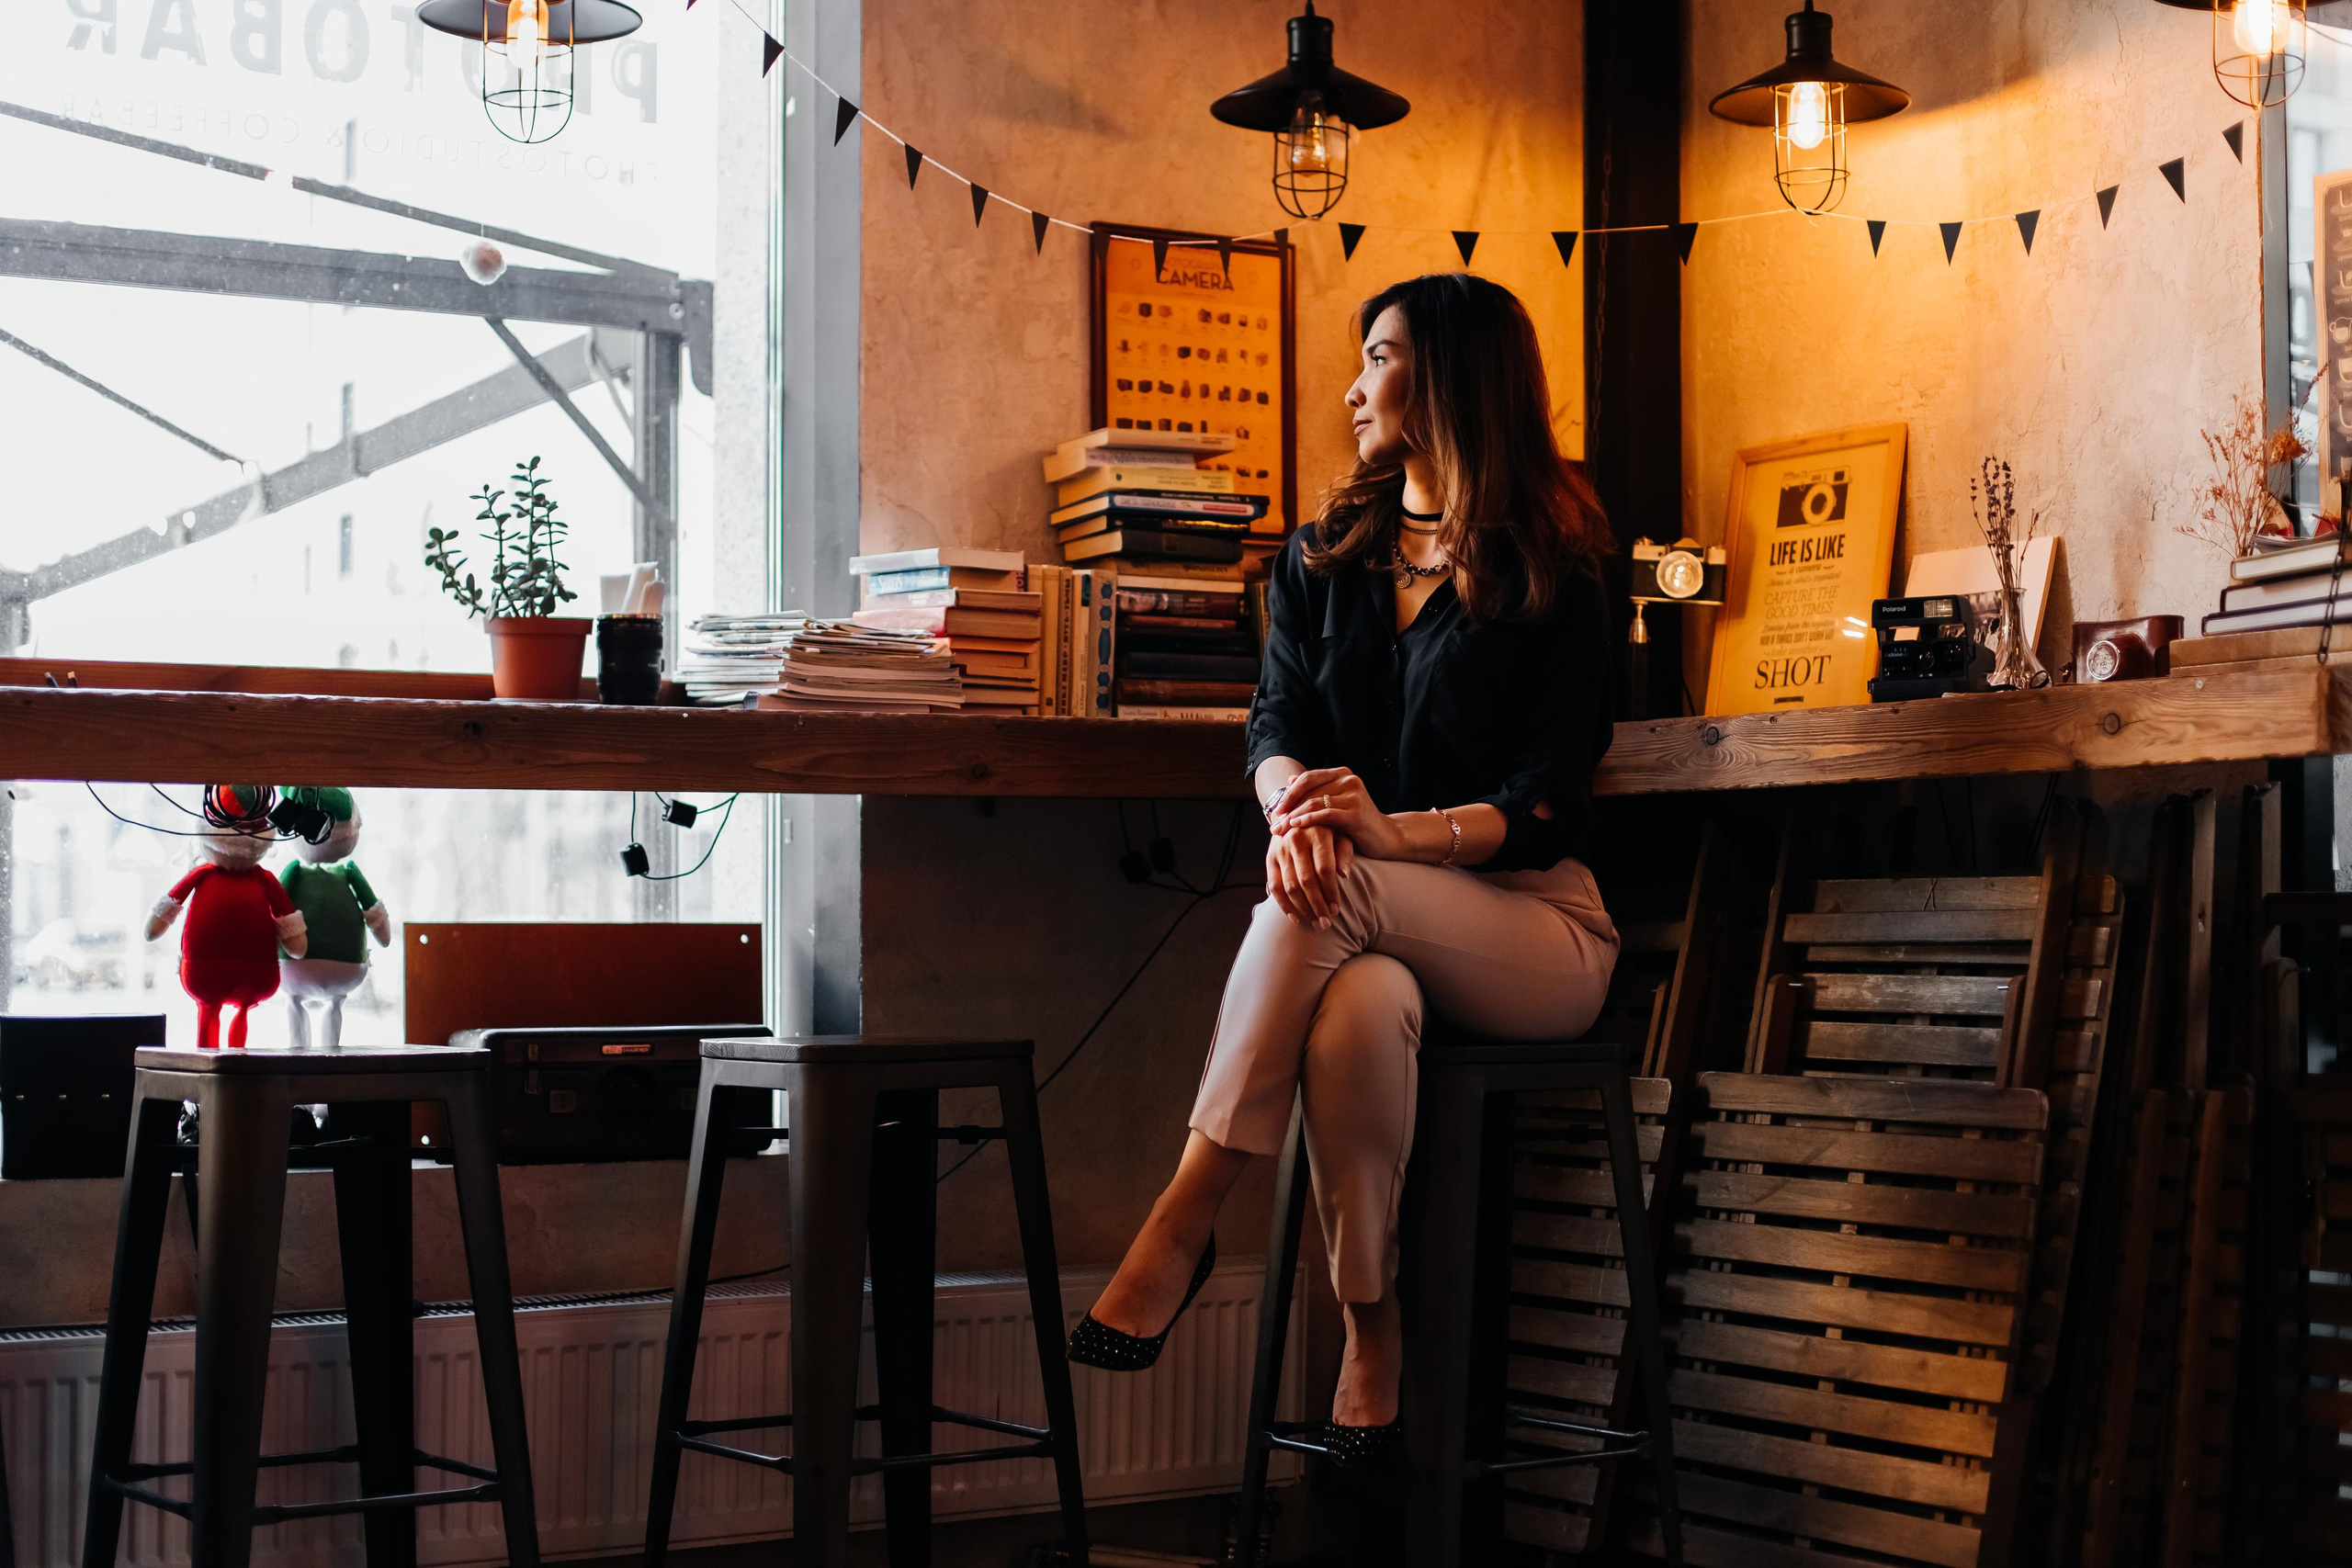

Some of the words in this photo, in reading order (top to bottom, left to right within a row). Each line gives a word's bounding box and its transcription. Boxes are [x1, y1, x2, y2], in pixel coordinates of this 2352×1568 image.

[1157, 269, 1235, 291] CAMERA
[1770, 540, 1797, 566] LIFE
[1800, 538, 1814, 562] IS
[1815, 534, 1846, 560] LIKE
[1764, 587, 1815, 605] CAPTURE
[1817, 584, 1839, 600] THE
[1766, 604, 1799, 619] GOOD
[1801, 600, 1834, 616] TIMES
[1755, 654, 1831, 689] SHOT
